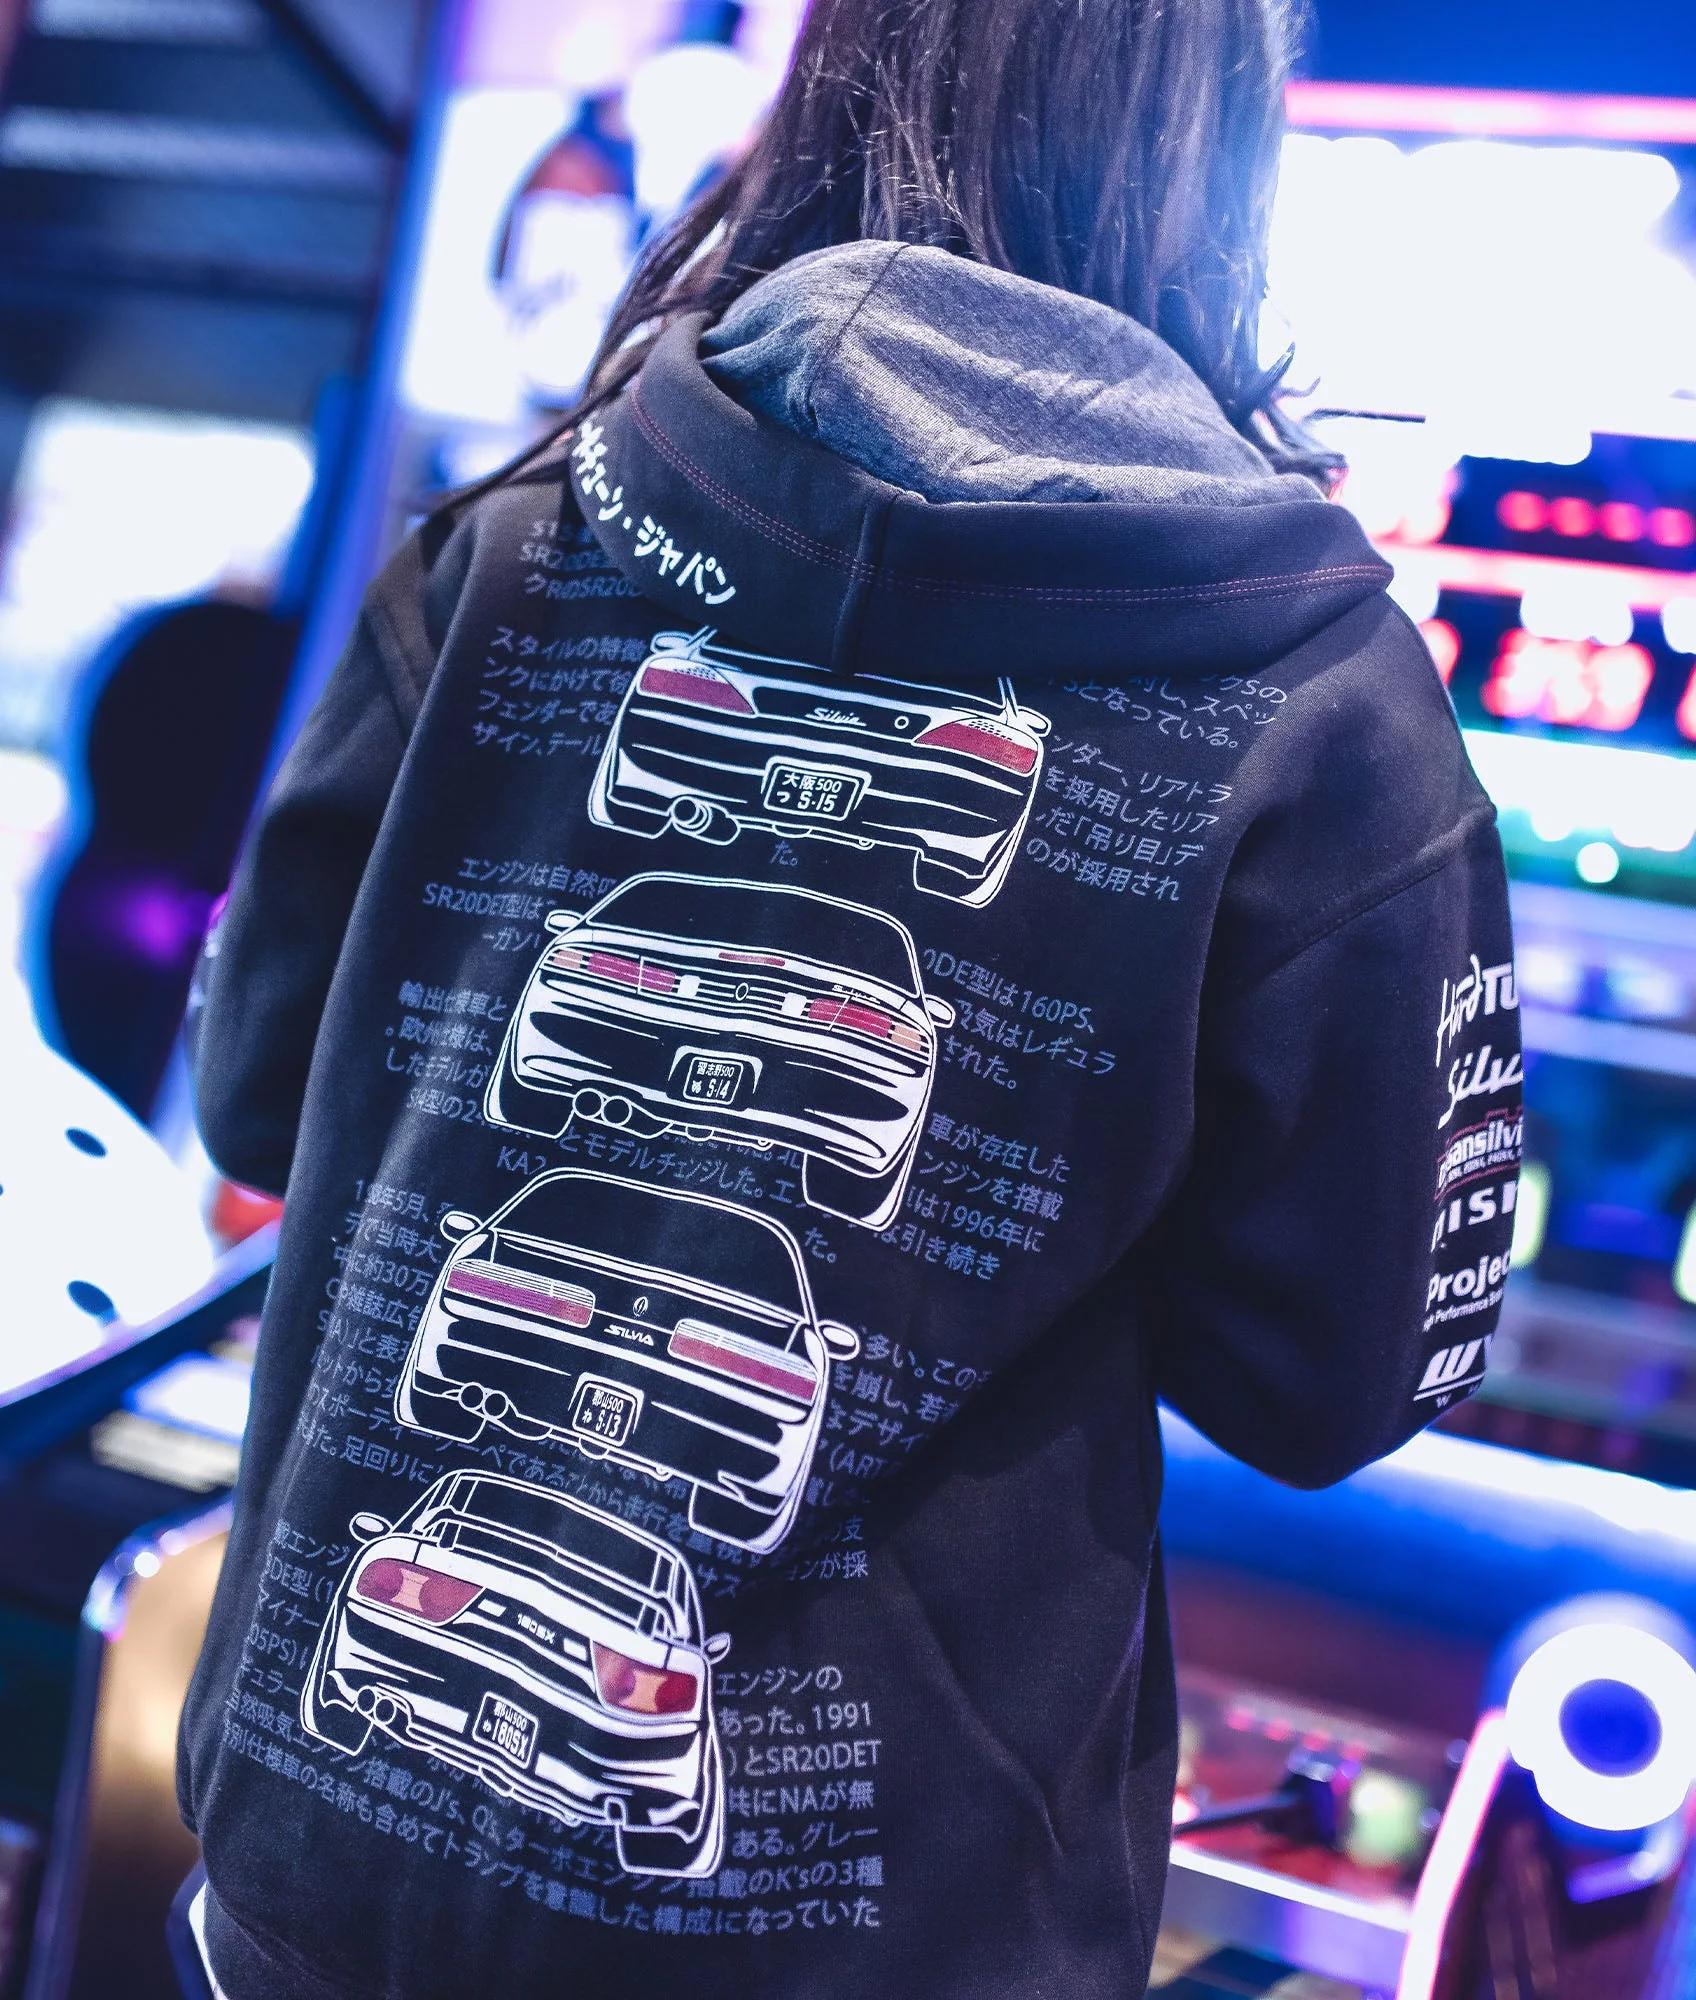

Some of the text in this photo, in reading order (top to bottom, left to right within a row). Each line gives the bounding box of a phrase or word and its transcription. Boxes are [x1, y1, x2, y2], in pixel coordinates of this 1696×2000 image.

[804, 707, 867, 727] Silvia
[604, 1324, 654, 1347] SILVIA
[716, 1665, 842, 1695] エンジンの
